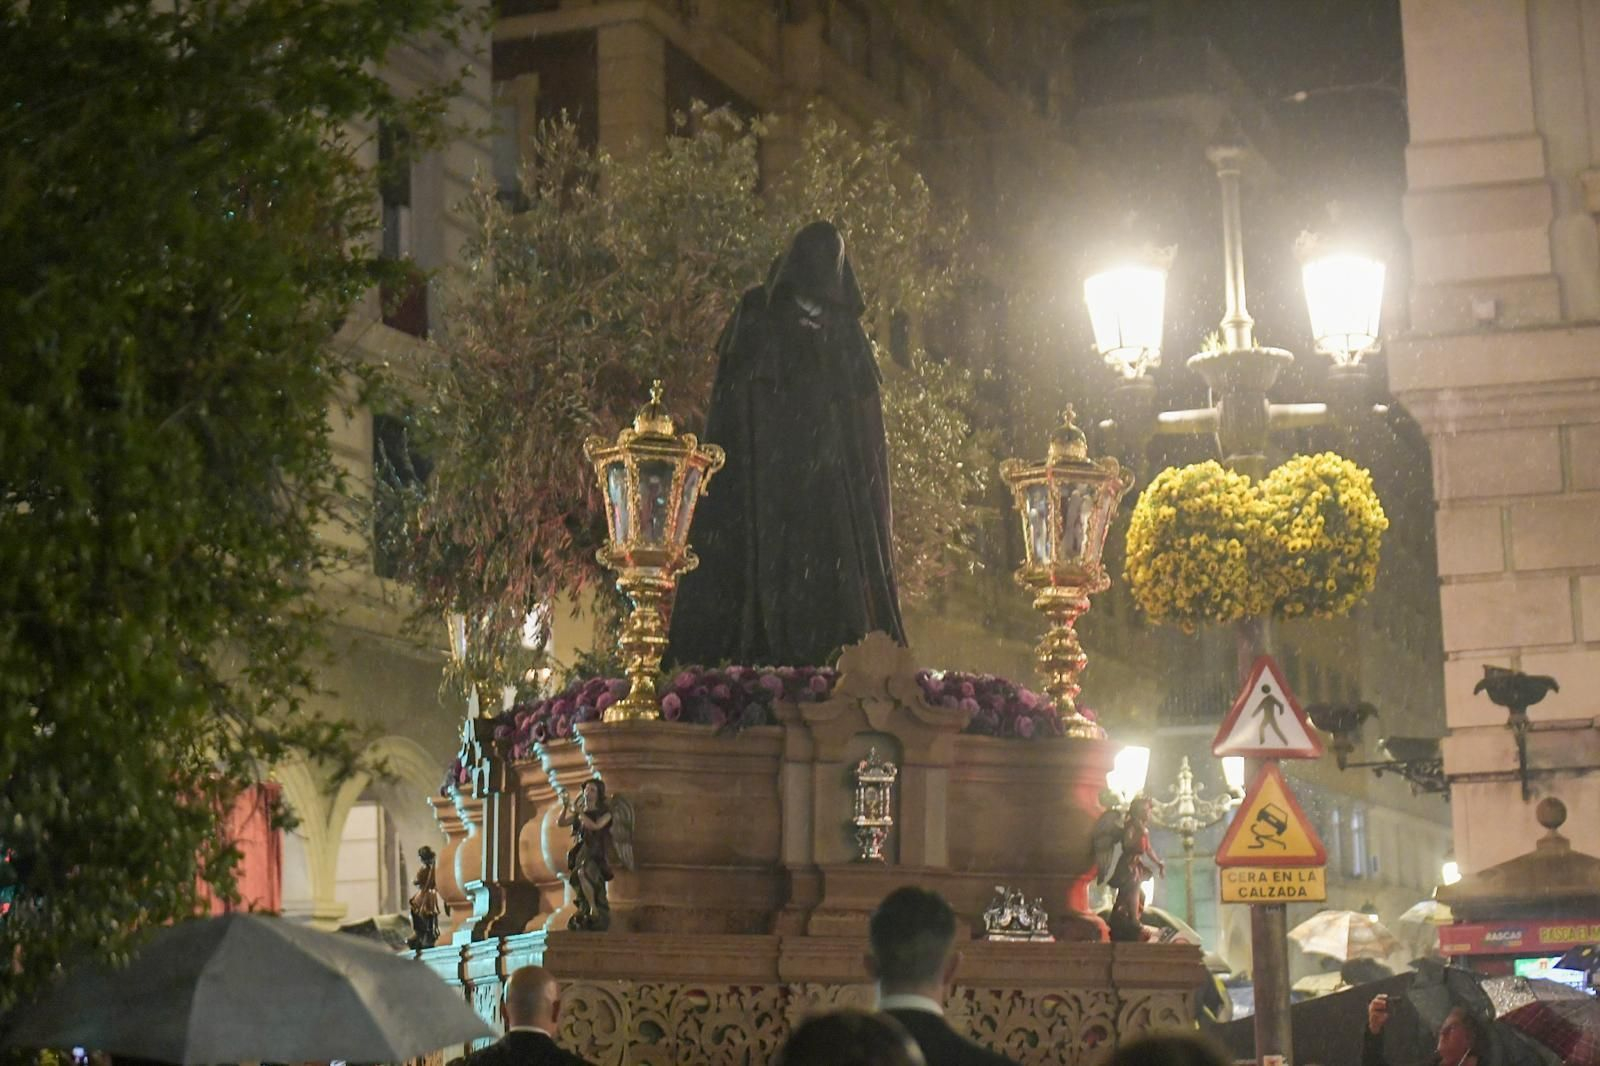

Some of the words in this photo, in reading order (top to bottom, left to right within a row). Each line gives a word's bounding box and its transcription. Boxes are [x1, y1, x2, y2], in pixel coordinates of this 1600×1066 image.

[1227, 871, 1267, 883] CERA
[1272, 871, 1292, 882] EN
[1298, 871, 1317, 882] LA
[1238, 886, 1308, 898] CALZADA
